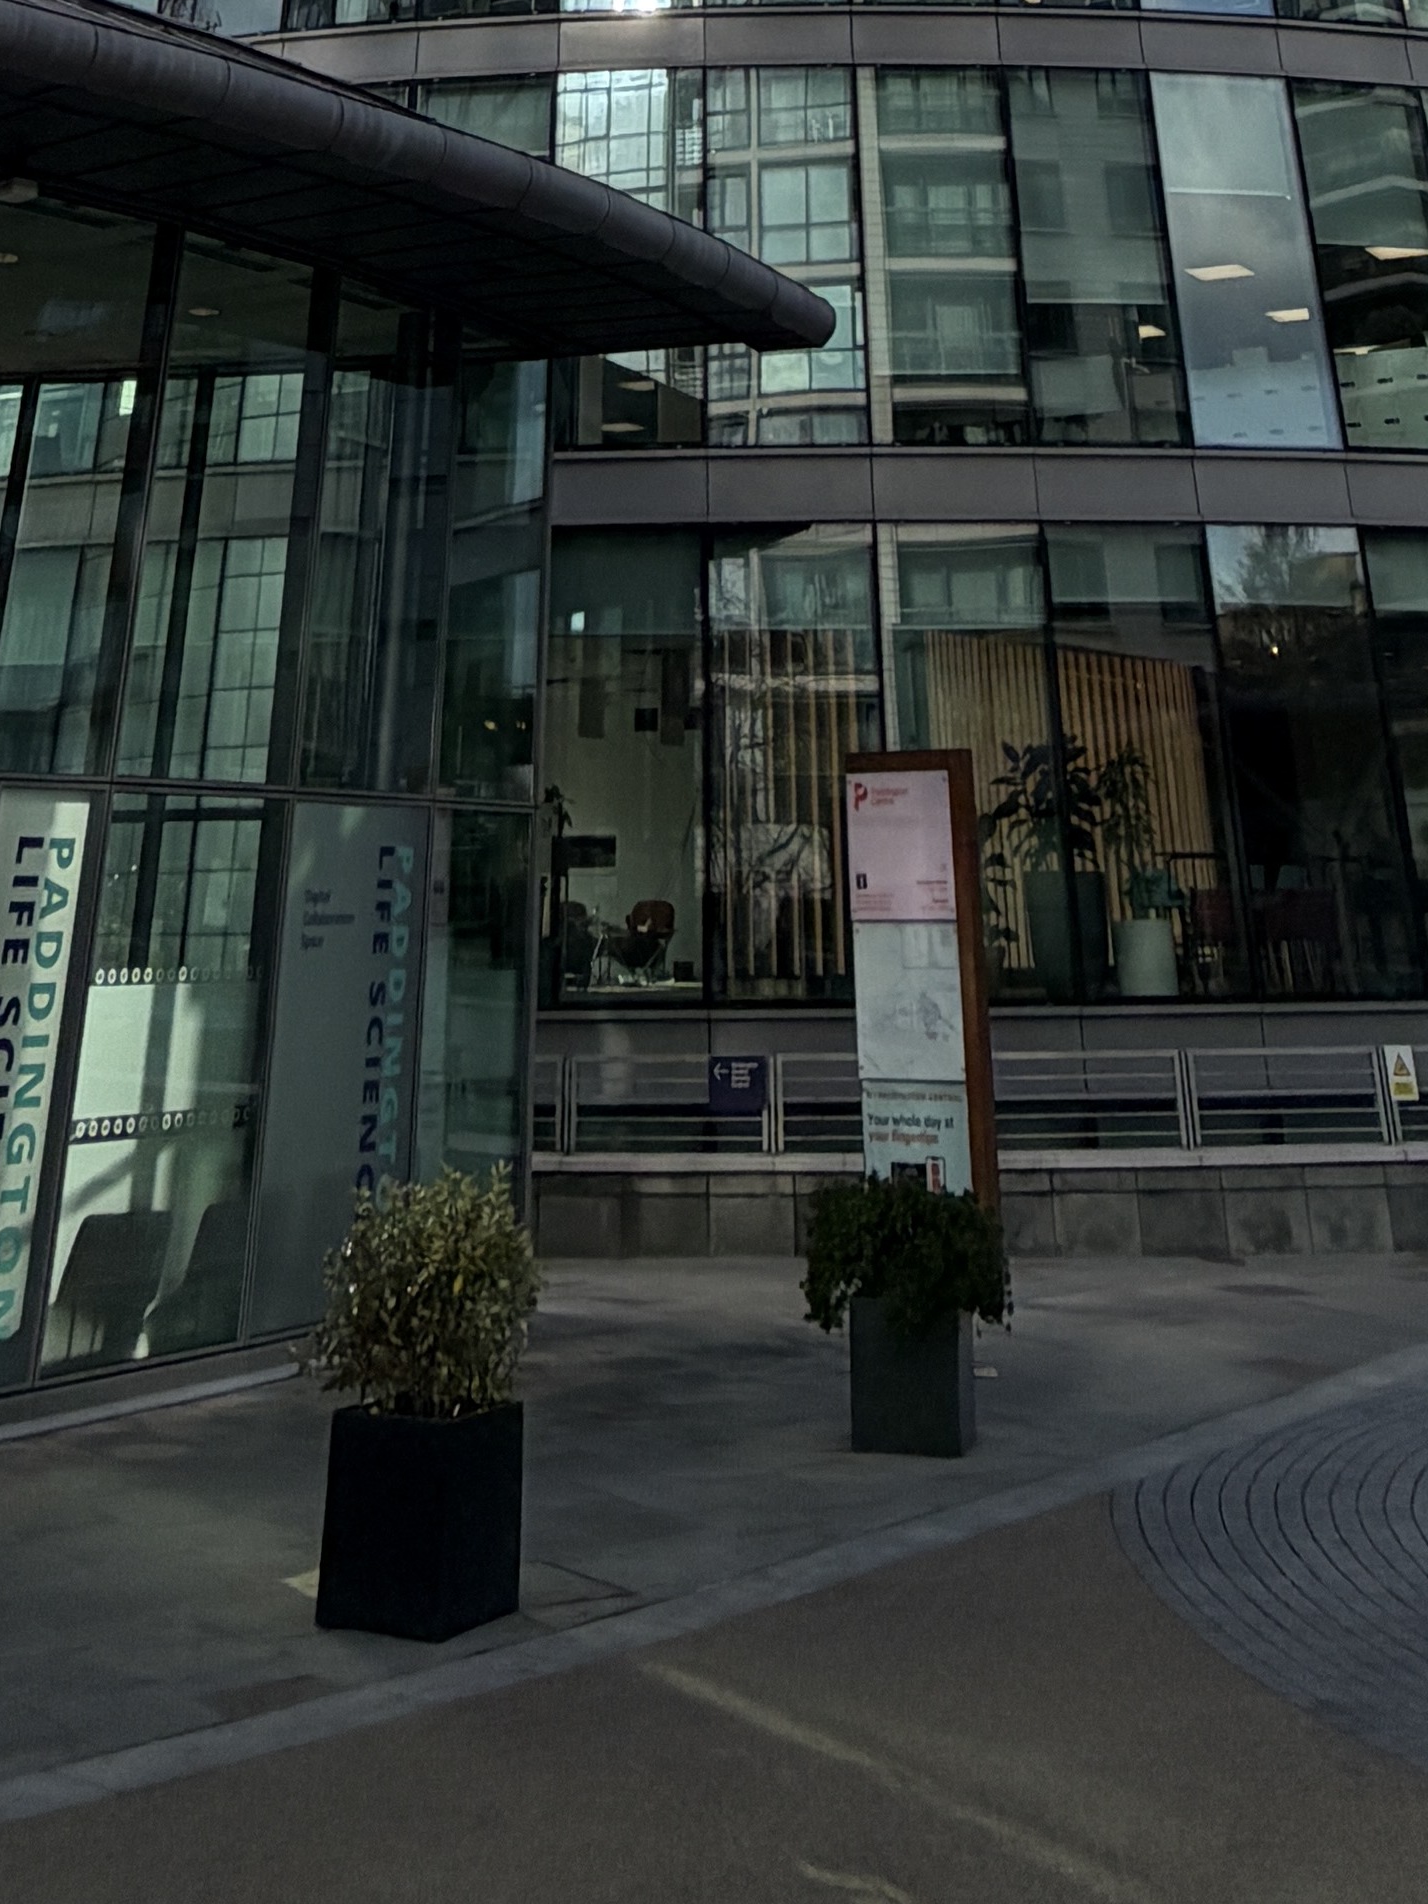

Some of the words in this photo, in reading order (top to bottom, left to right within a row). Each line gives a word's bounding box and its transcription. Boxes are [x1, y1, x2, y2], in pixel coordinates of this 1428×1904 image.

[1, 835, 45, 966] LIFE
[372, 845, 395, 955] LIFE
[356, 981, 386, 1194] SCIENC
[376, 846, 415, 1212] PADDINGTO
